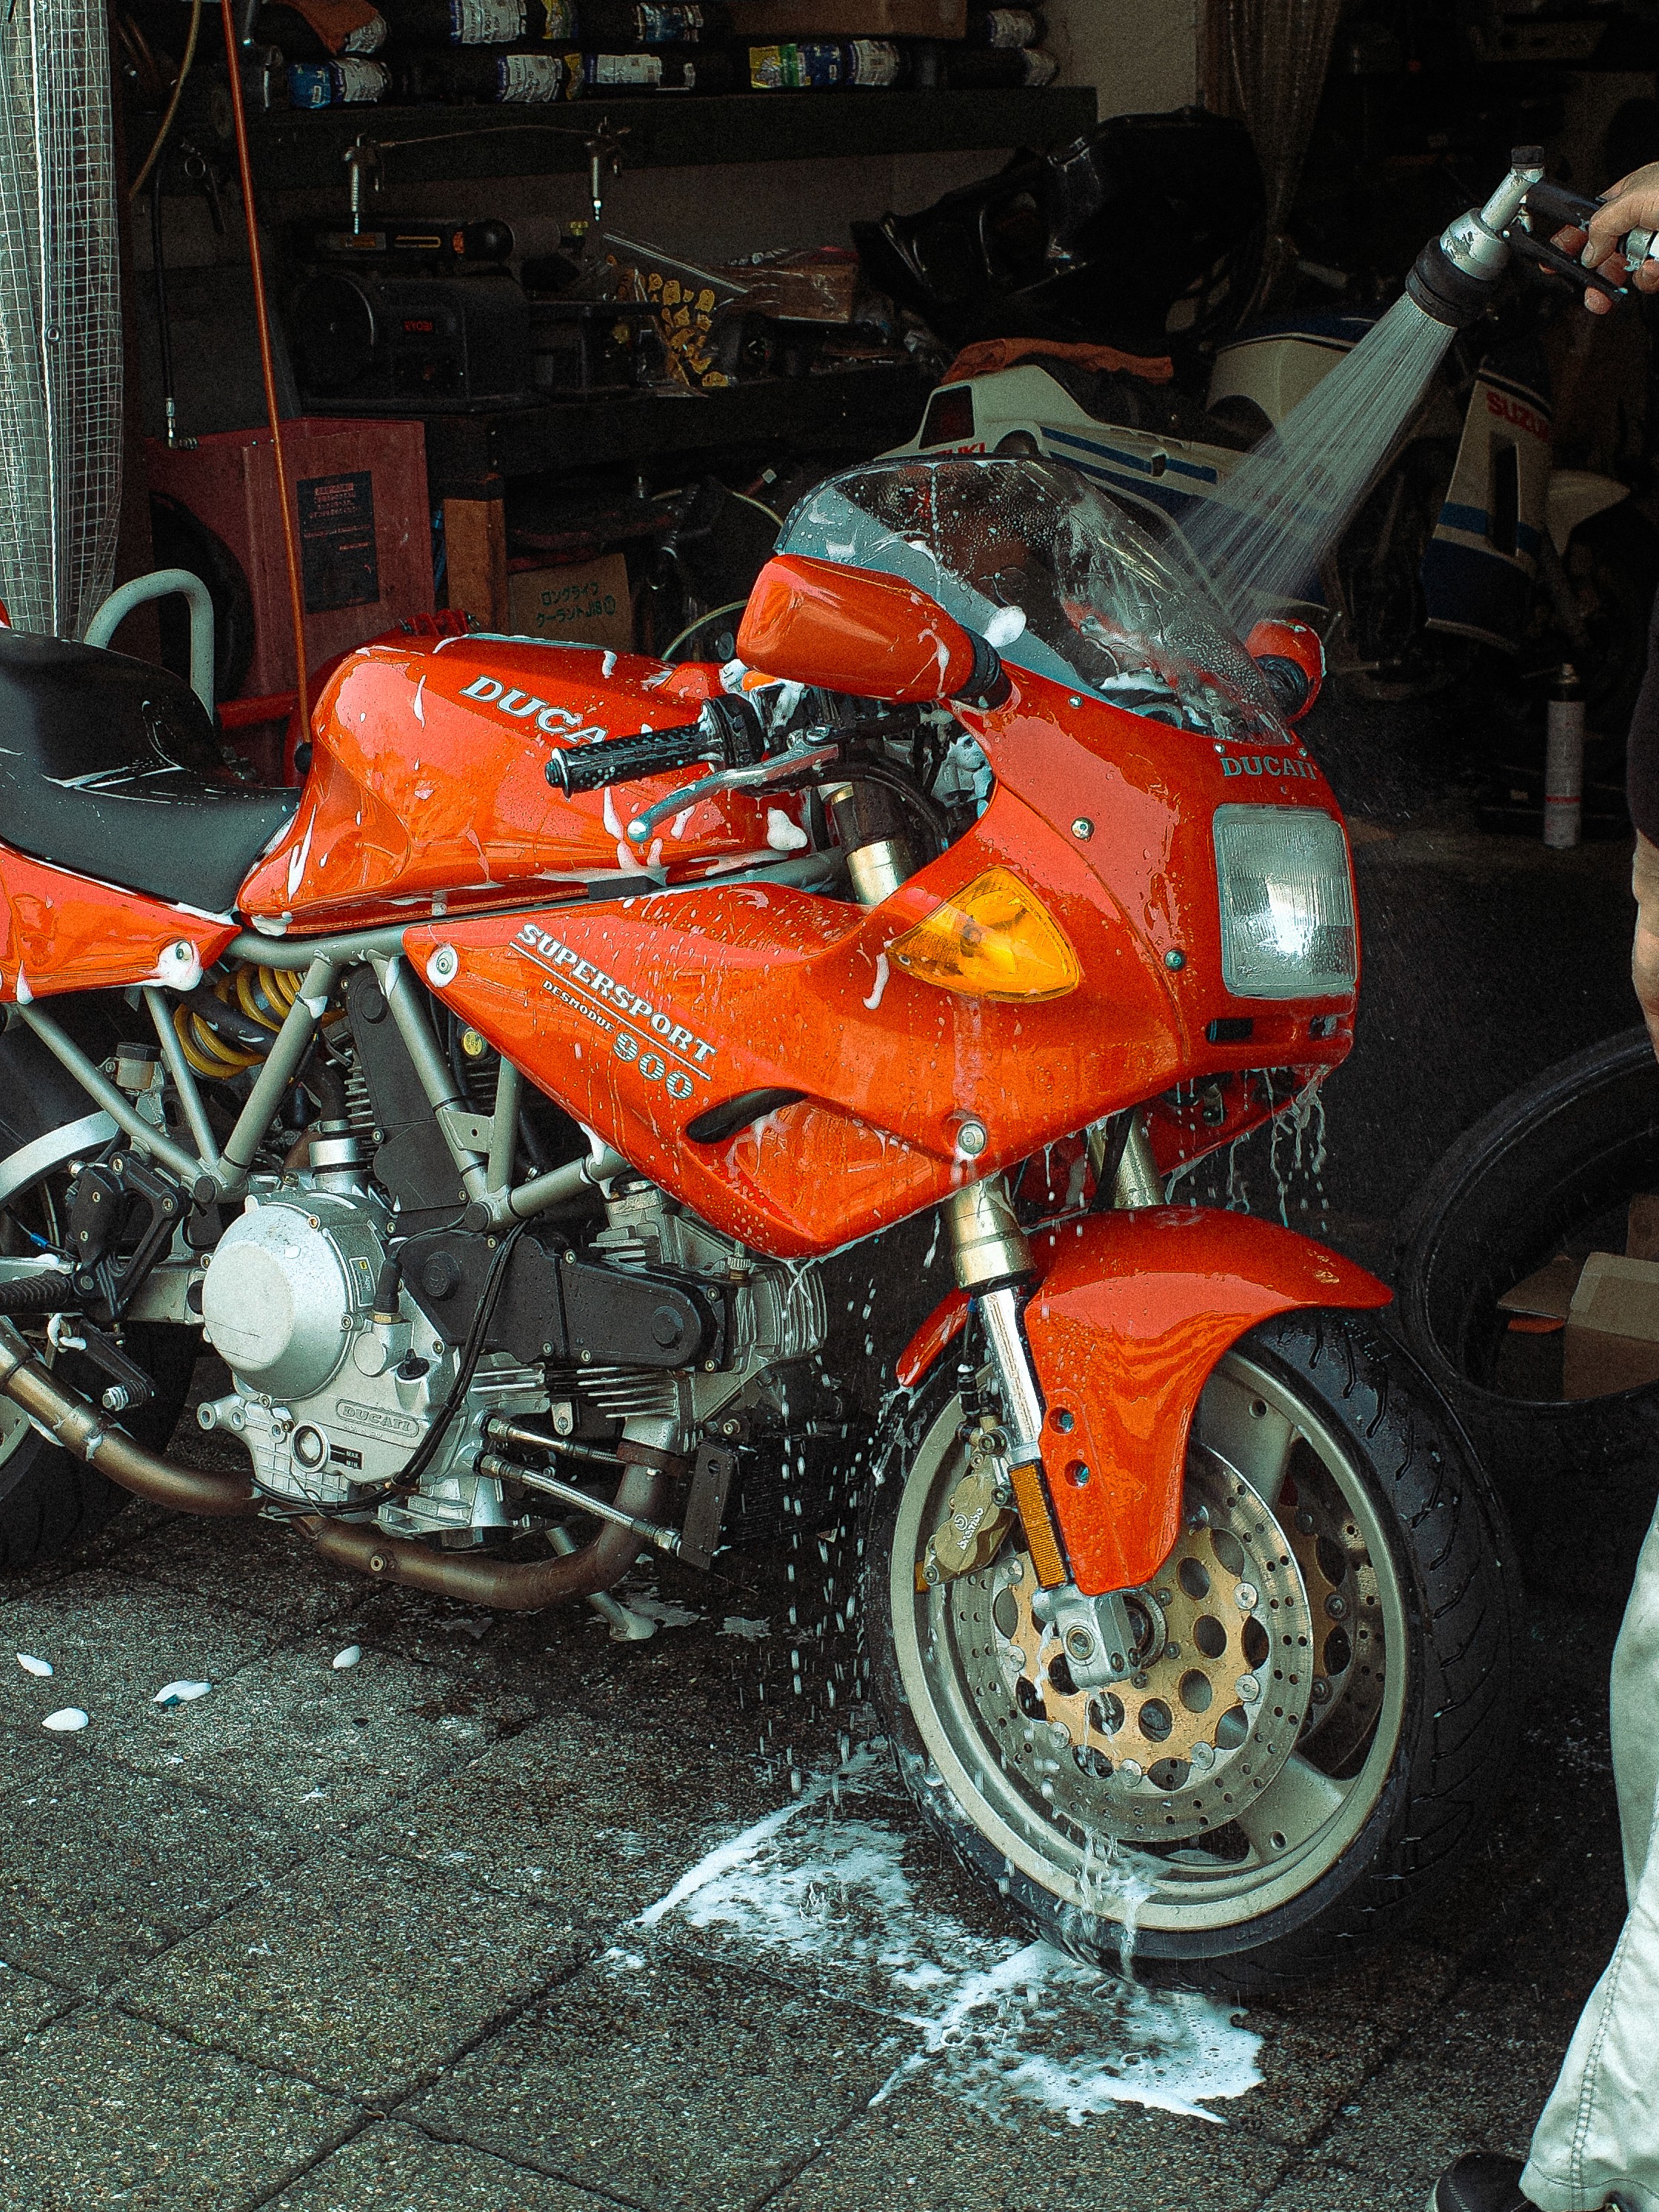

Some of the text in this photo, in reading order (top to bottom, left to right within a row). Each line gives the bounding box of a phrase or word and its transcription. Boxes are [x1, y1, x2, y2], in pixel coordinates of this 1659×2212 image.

[541, 581, 598, 607] ロングライフ
[460, 675, 608, 744] DUCA
[1220, 755, 1317, 780] DUCATI
[516, 922, 718, 1063] SUPERSPORT
[541, 979, 694, 1099] DESMODUE 900
[342, 1406, 411, 1431] DUCATI
[956, 1506, 984, 1551] brembo
